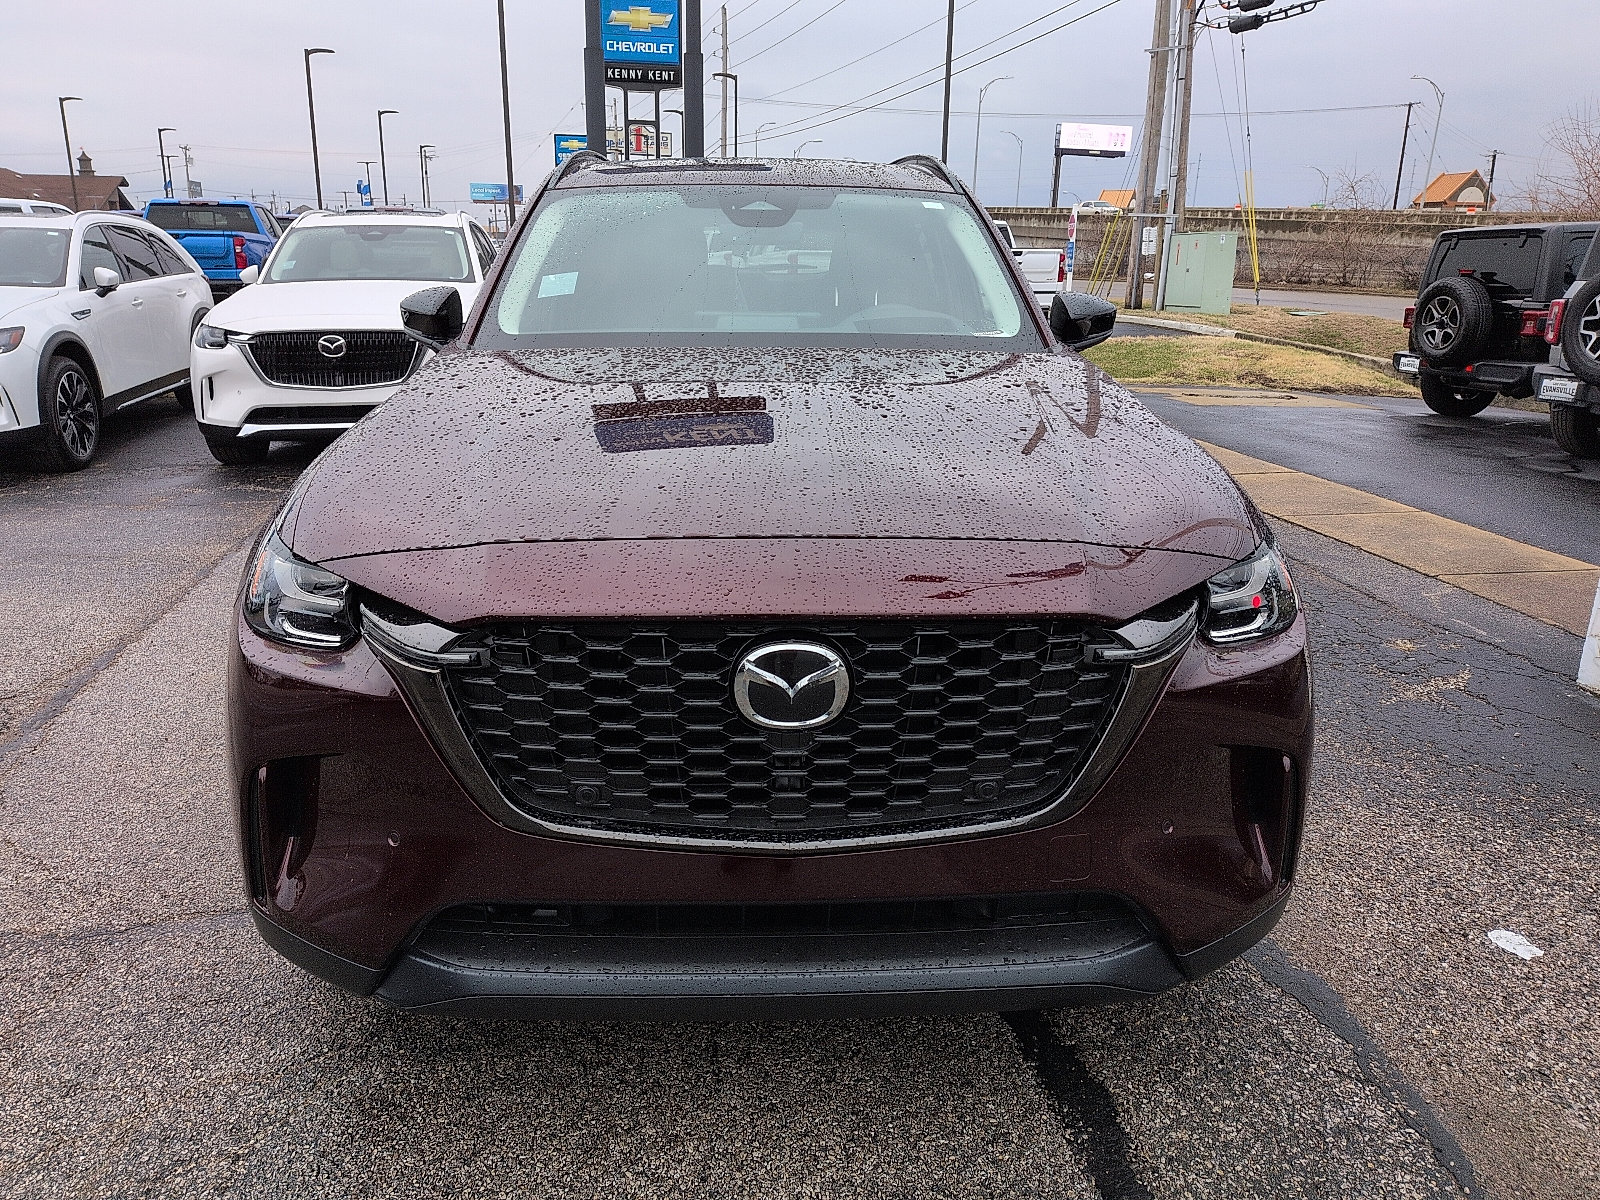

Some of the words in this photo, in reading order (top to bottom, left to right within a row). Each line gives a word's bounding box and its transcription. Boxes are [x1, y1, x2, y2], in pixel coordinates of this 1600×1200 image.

[606, 40, 675, 54] CHEVROLET
[607, 68, 643, 80] KENNY
[648, 70, 675, 81] KENT
[1542, 385, 1576, 397] EVANSVILLE
